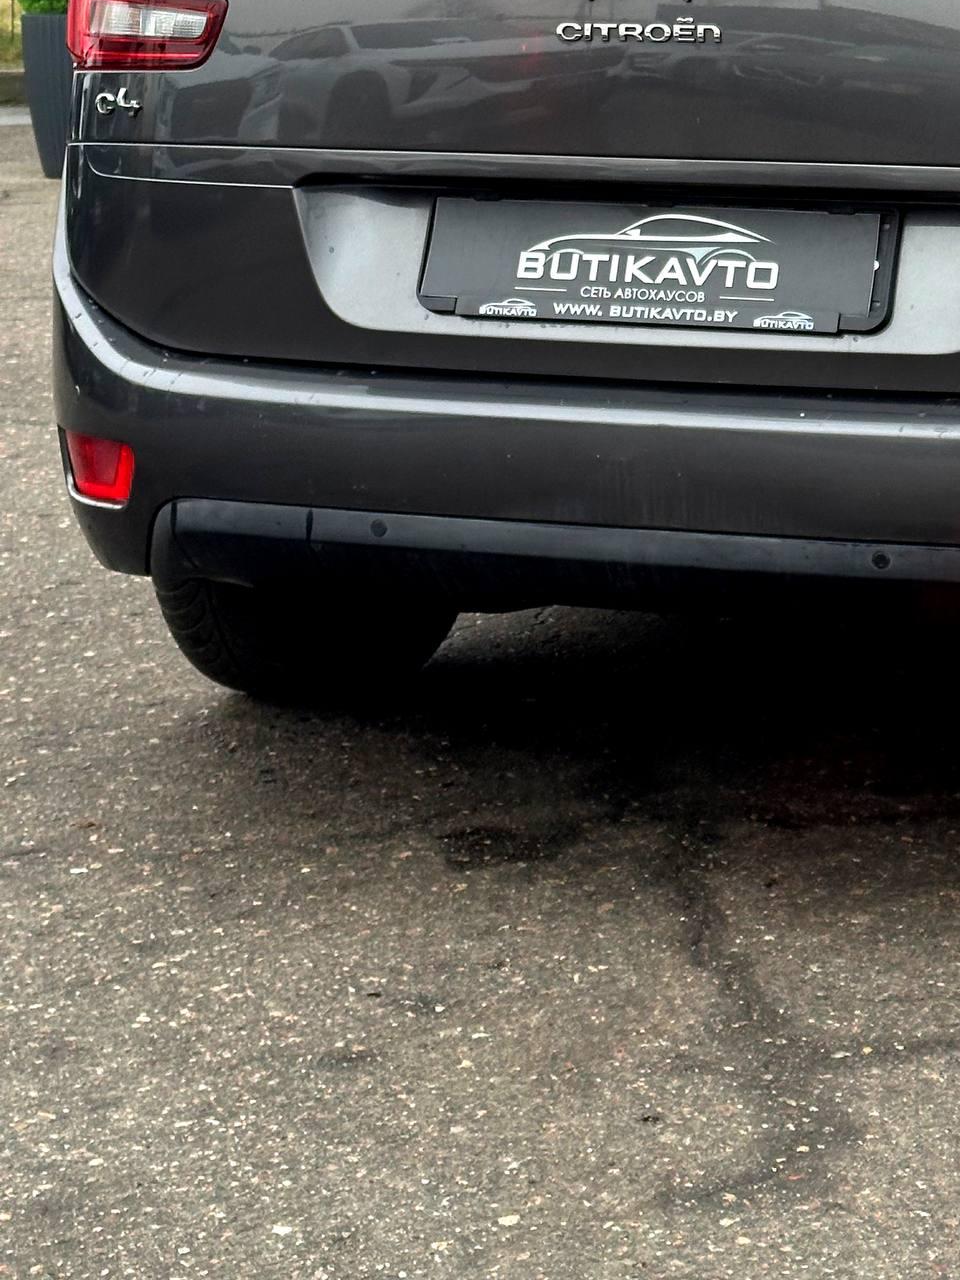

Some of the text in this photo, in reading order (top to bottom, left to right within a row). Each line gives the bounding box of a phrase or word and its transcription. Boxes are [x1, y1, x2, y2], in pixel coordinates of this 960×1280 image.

[516, 251, 779, 290] BUTIKAVTO
[580, 285, 705, 303] СЕТЬ АВТОХАУСОВ
[478, 305, 537, 317] BUTIKAVTO
[609, 304, 738, 322] BUTIKAVTO.BY
[753, 318, 814, 331] BUTIKAVTO
